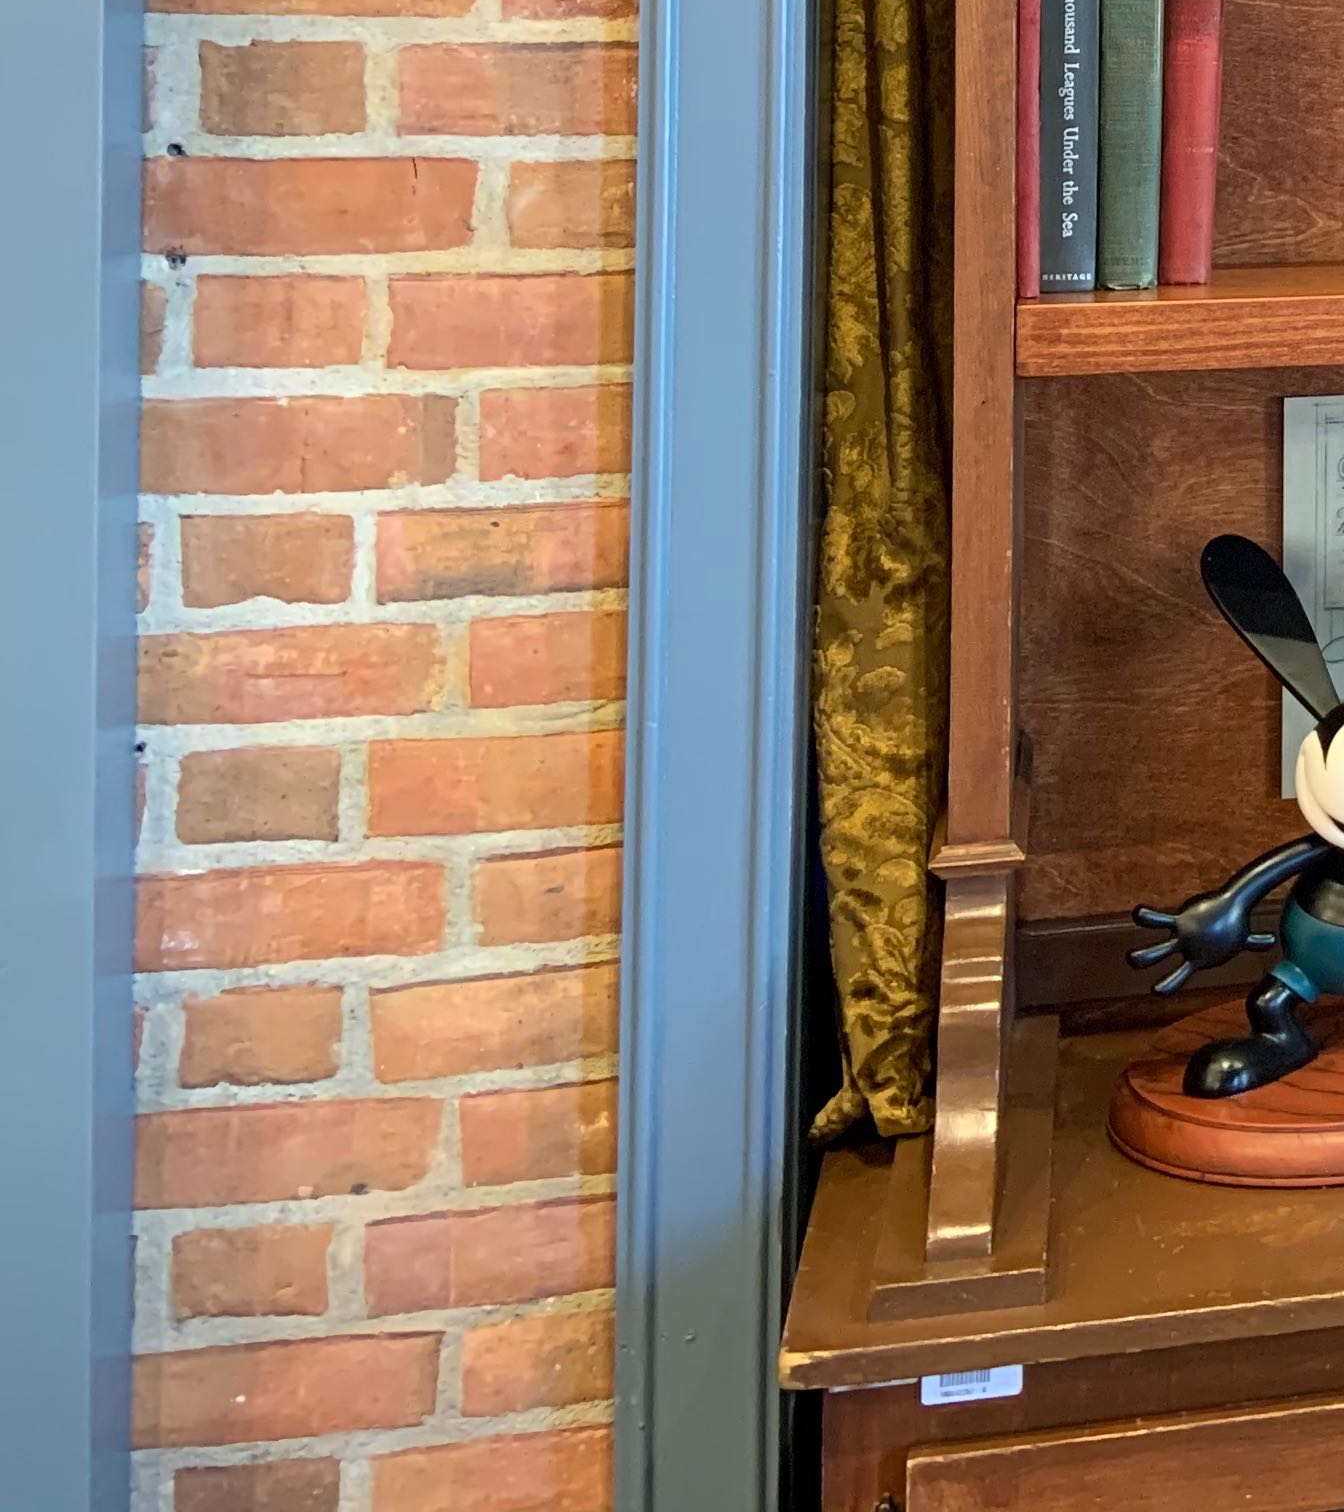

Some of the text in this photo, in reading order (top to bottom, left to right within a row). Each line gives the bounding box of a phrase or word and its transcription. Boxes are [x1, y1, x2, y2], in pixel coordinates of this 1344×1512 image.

[1058, 62, 1081, 122] Leagues
[1063, 126, 1080, 172] Under
[1062, 176, 1080, 206] the
[1061, 211, 1079, 239] Sea
[1041, 272, 1093, 282] HERITAGE
